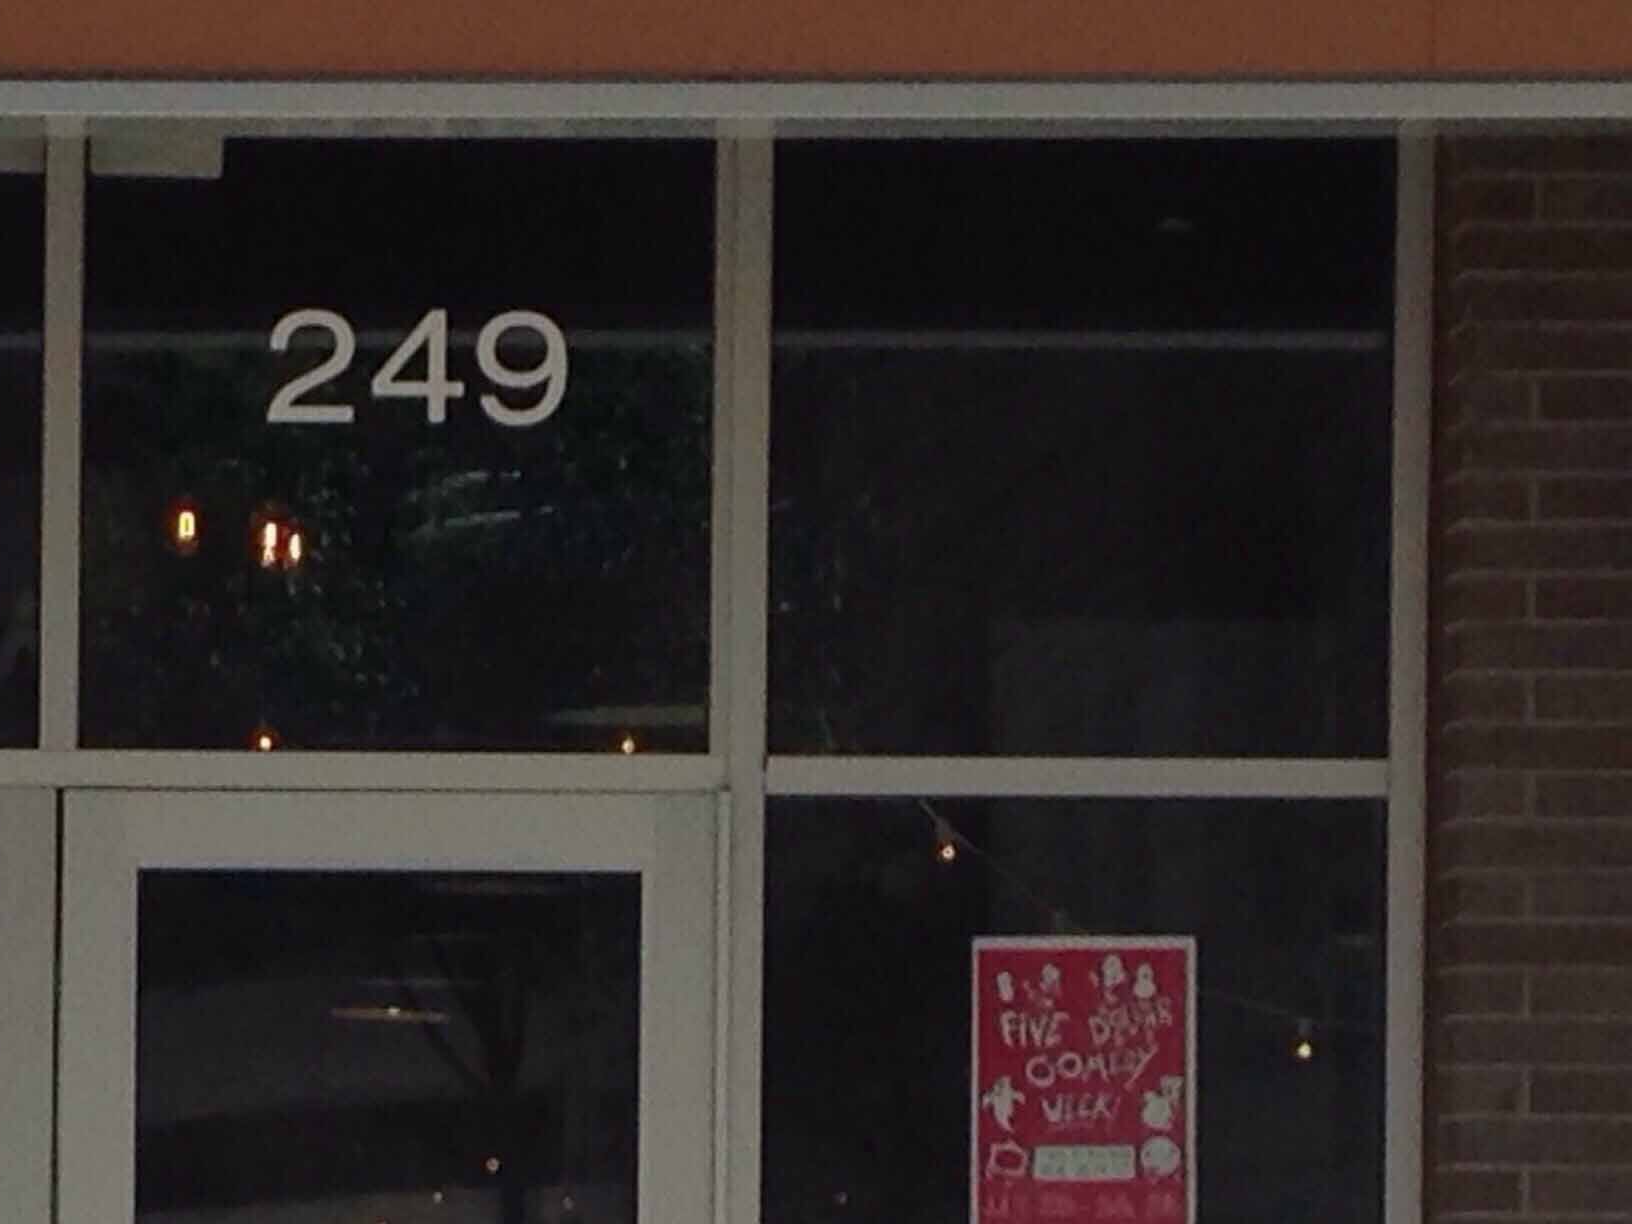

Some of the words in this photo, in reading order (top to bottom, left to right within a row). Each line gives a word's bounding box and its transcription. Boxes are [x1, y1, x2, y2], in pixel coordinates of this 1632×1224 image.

[267, 308, 567, 426] 249
[1000, 1008, 1070, 1047] FIVE
[1025, 1044, 1159, 1091] COMEDY
